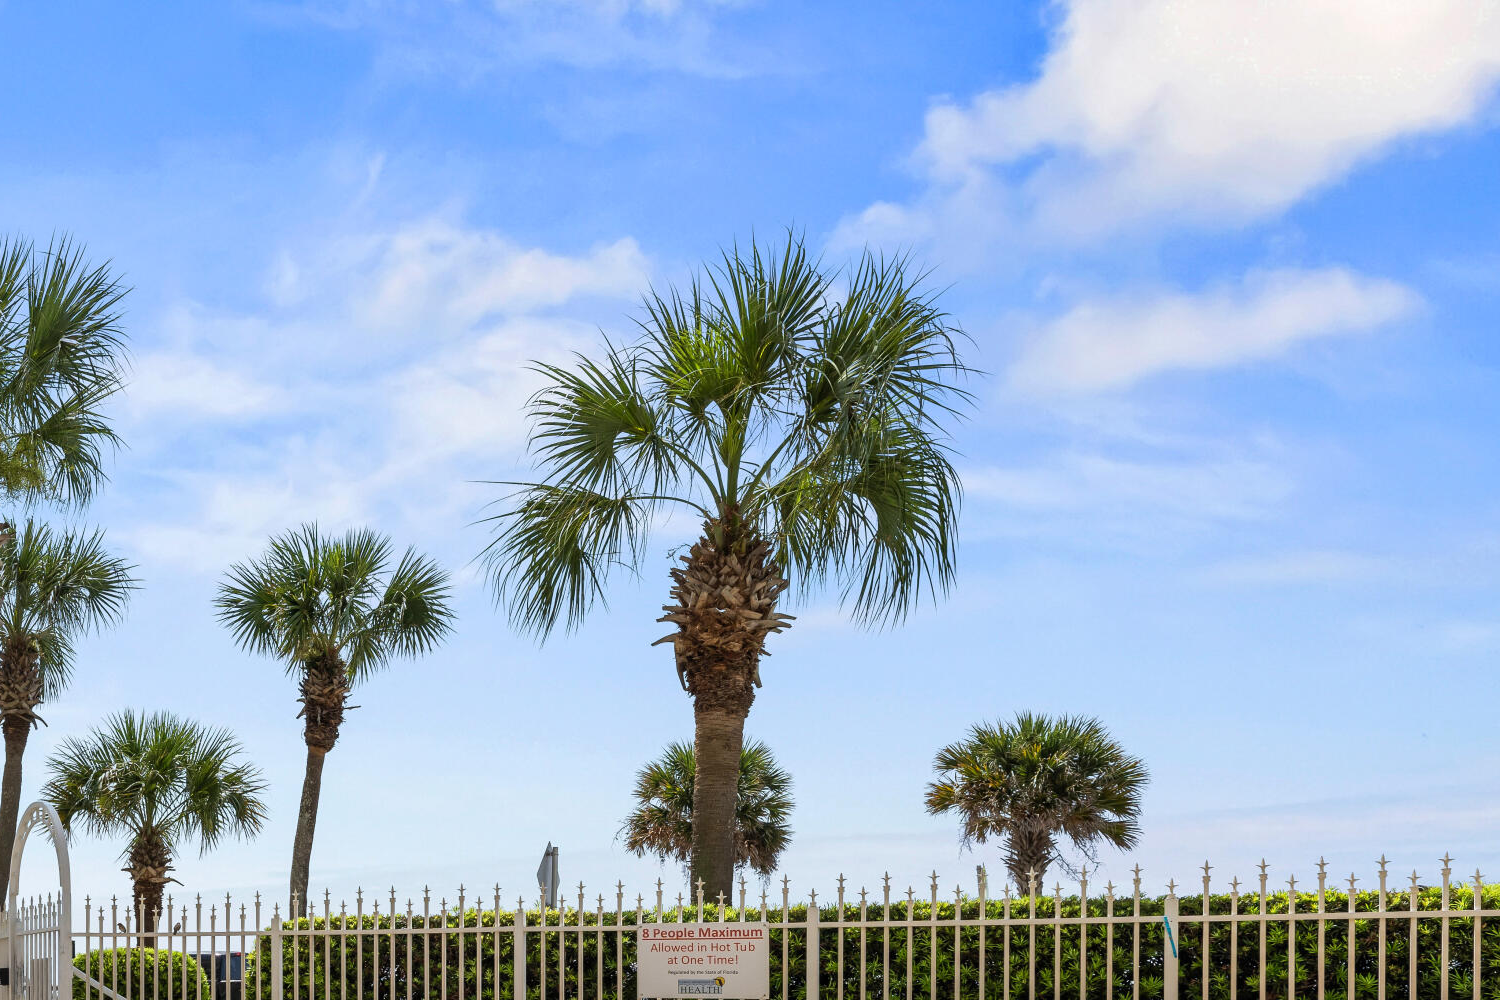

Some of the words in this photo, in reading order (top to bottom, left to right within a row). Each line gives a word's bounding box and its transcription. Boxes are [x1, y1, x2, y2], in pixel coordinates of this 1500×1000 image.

[642, 929, 649, 938] 8
[654, 928, 694, 939] People
[699, 927, 763, 937] Maximum
[651, 943, 693, 952] Allowed
[698, 943, 707, 951] in
[711, 943, 730, 951] Hot
[734, 942, 755, 951] Tub
[682, 956, 703, 964] One
[707, 955, 738, 964] Time!
